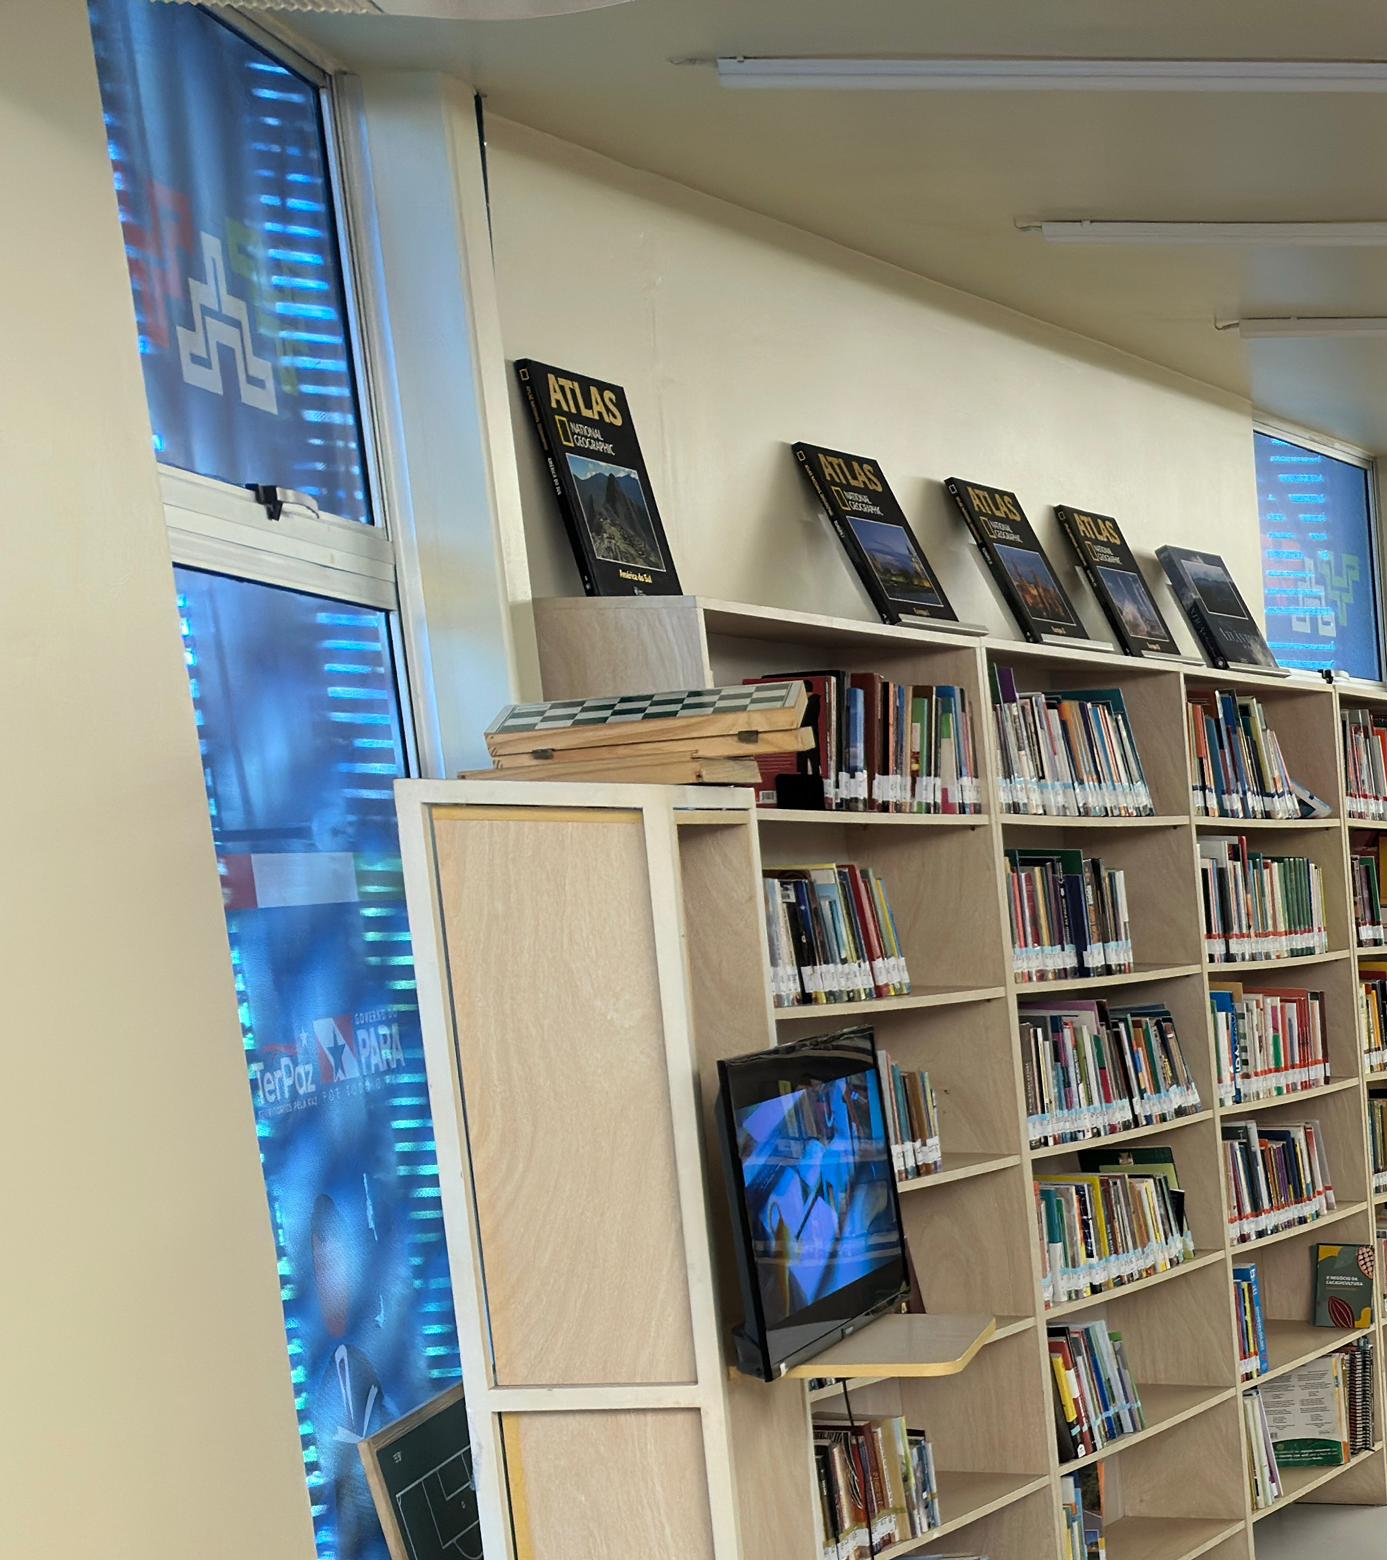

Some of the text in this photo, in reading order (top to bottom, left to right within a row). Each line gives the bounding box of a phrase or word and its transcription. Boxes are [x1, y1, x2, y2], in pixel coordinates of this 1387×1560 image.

[548, 374, 622, 426] ATLAS
[570, 422, 603, 441] NATIONAL
[573, 435, 615, 455] GEOGRAPHIC
[818, 454, 882, 492] ATLAS
[967, 487, 1021, 521] ATLAS
[1075, 513, 1120, 545] ATLAS
[252, 1056, 316, 1105] TerPaz
